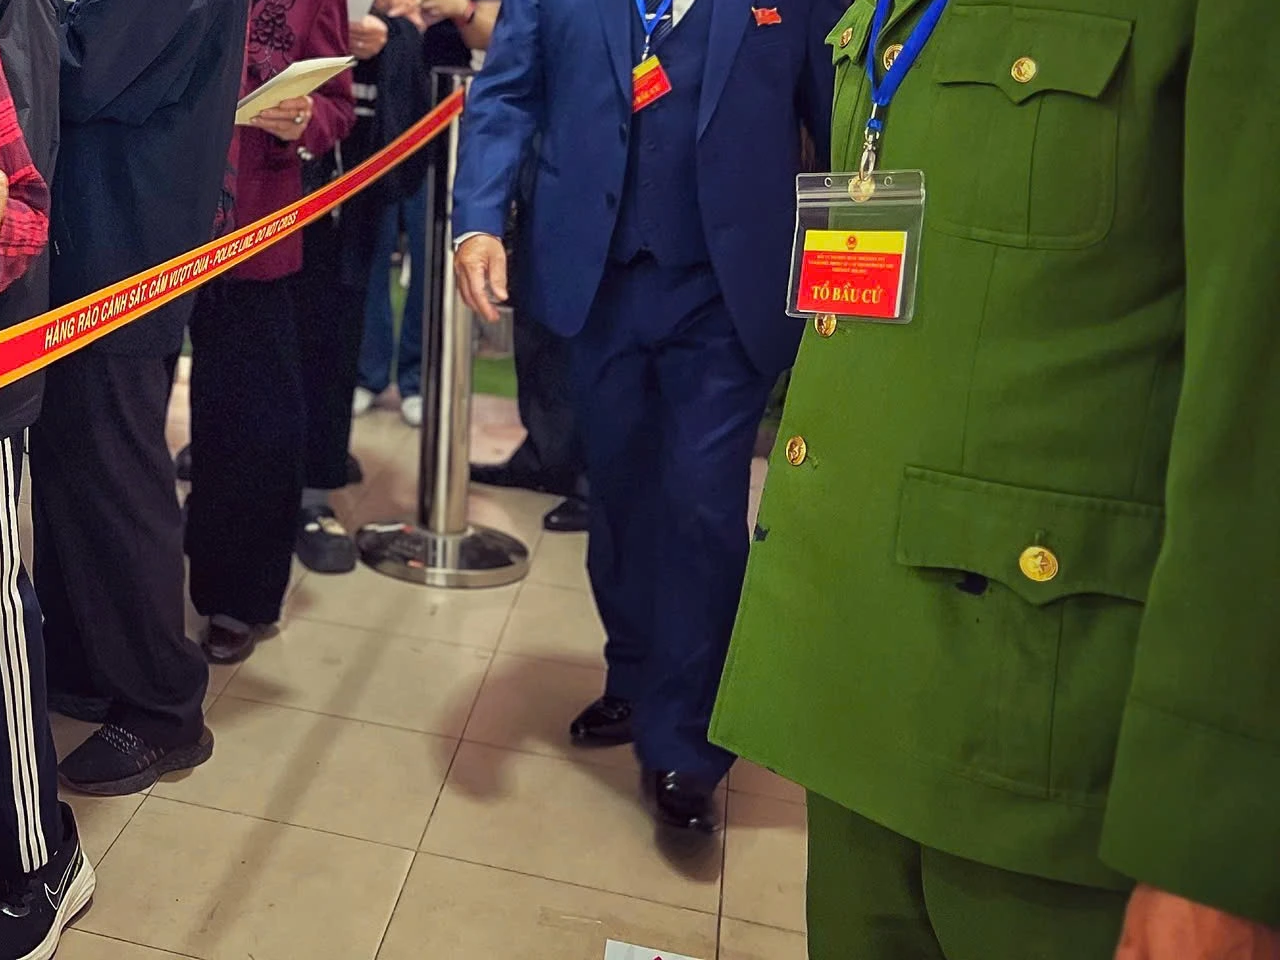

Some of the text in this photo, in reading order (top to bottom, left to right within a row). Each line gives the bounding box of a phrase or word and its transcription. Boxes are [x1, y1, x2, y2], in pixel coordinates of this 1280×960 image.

[44, 317, 75, 350] HÀNG
[77, 304, 99, 333] RÀO
[101, 293, 127, 321] CẢNH
[149, 271, 168, 298] CẤM
[169, 262, 194, 286] VƯỢT
[193, 255, 209, 276] QUA
[213, 240, 240, 266] POLICE
[255, 227, 266, 243] DO
[265, 220, 280, 238] NOT
[812, 281, 883, 304] TỔ BẦU CỬ
